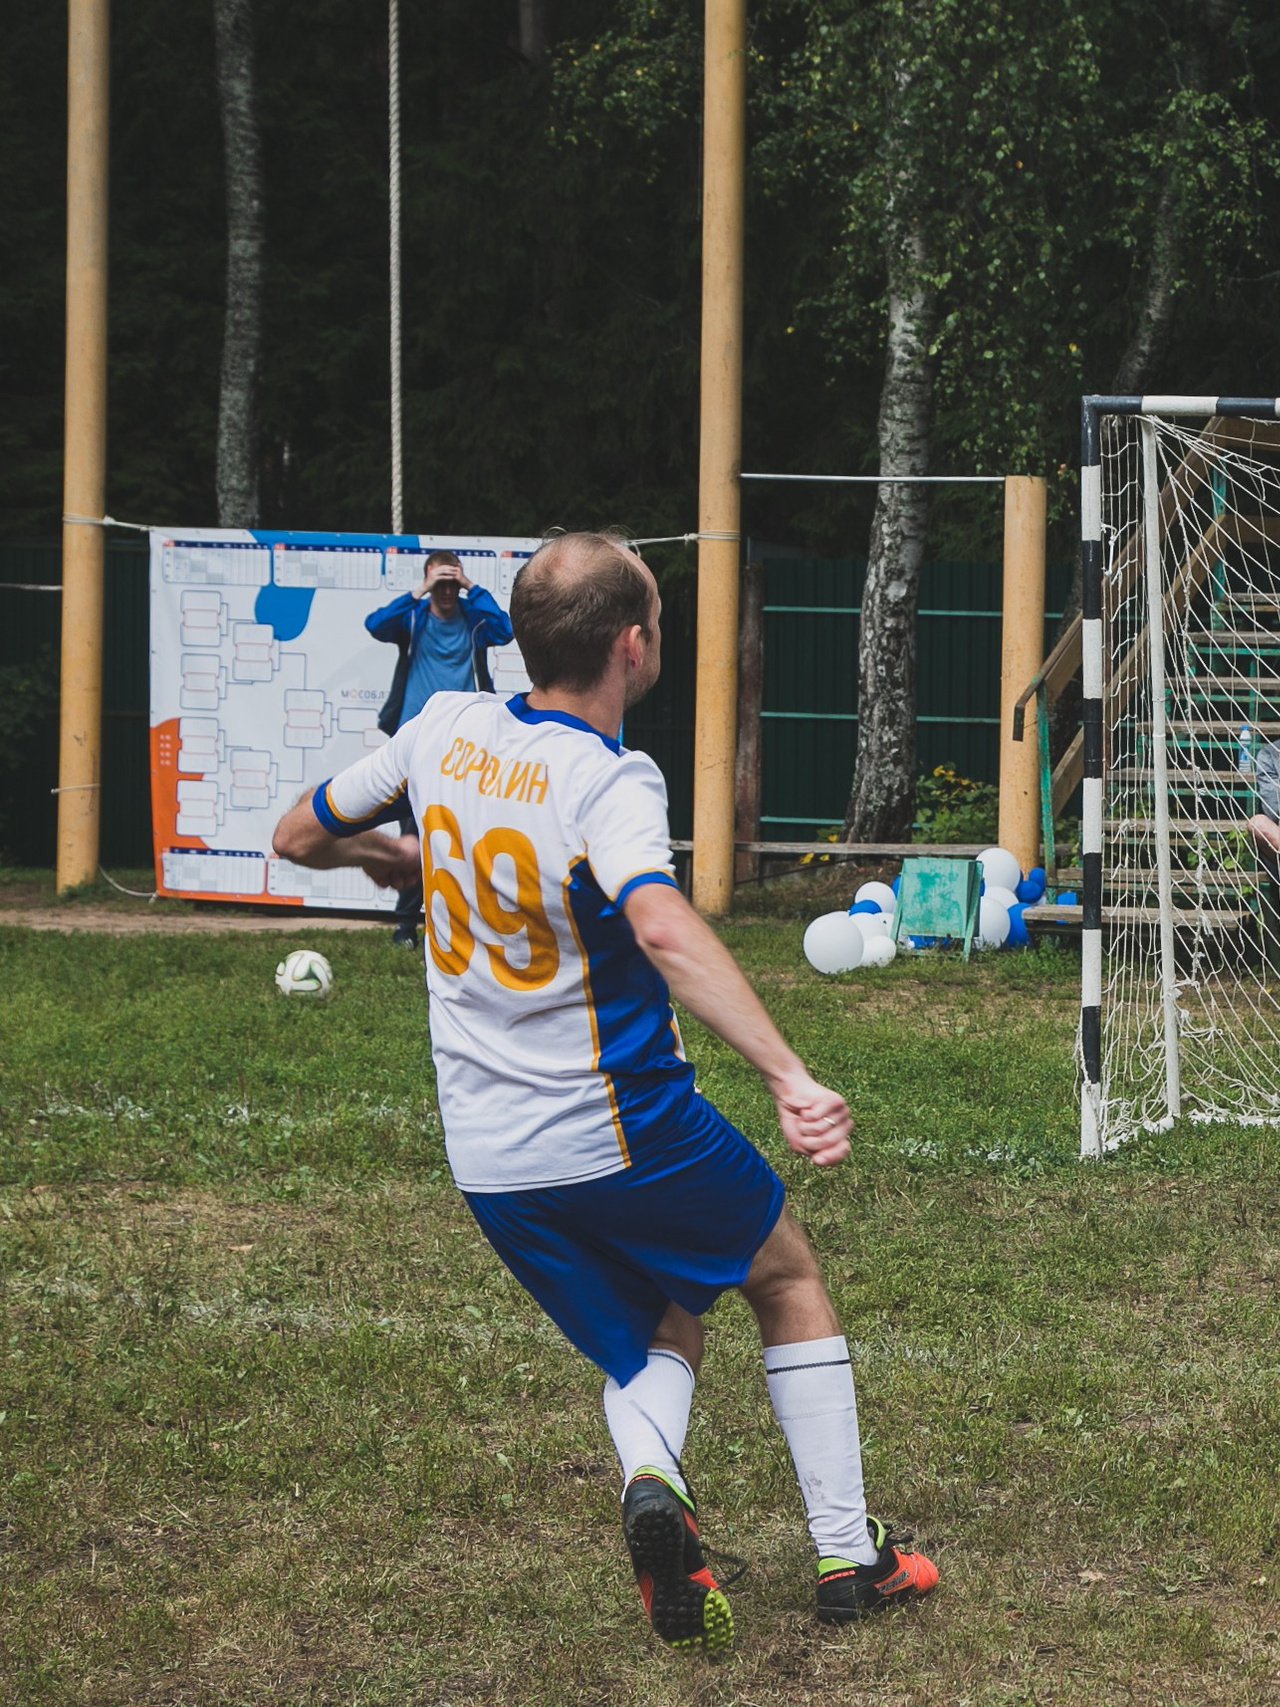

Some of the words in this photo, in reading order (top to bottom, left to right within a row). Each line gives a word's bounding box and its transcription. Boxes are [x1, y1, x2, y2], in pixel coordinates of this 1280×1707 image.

[341, 689, 390, 699] МОСОБЛ
[440, 736, 549, 804] СОРОКИН
[422, 804, 560, 991] 69
